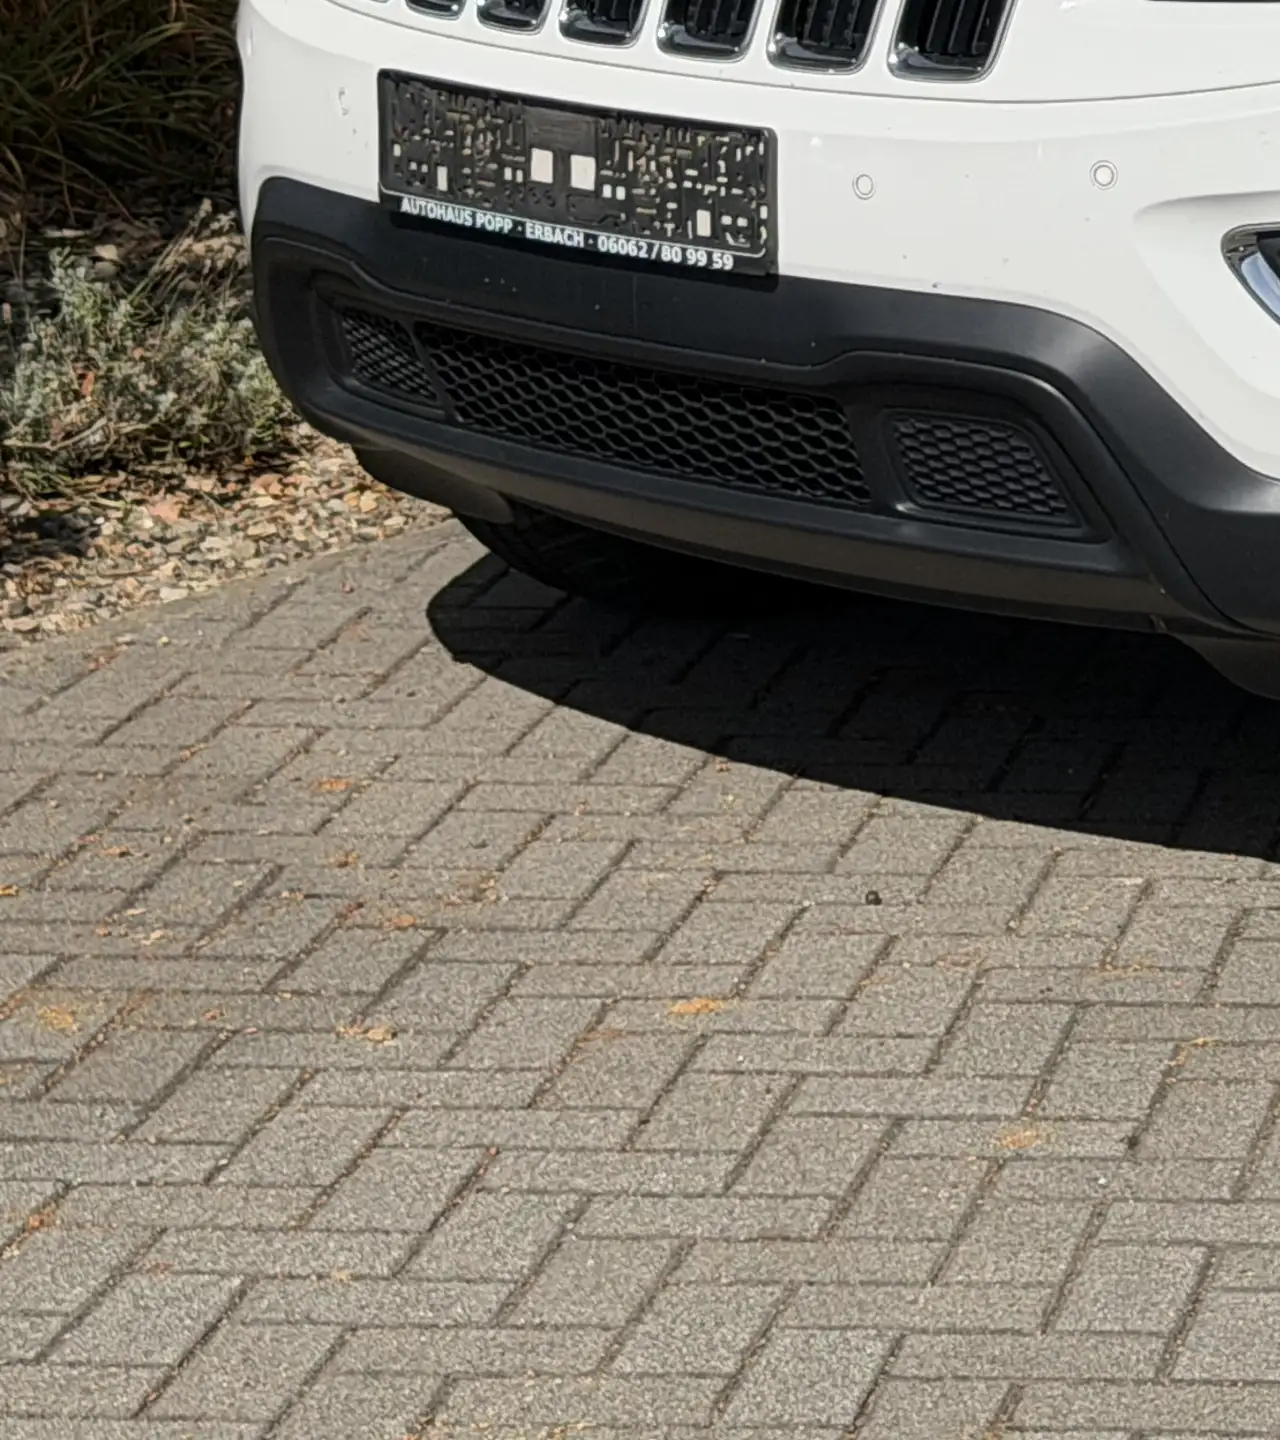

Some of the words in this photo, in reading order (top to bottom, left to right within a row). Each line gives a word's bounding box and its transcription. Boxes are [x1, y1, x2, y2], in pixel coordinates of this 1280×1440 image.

[399, 196, 473, 228] AUTOHAUS
[475, 212, 513, 235] POPP
[525, 222, 585, 249] ERBACH
[686, 248, 708, 267] 99
[711, 253, 735, 271] 59
